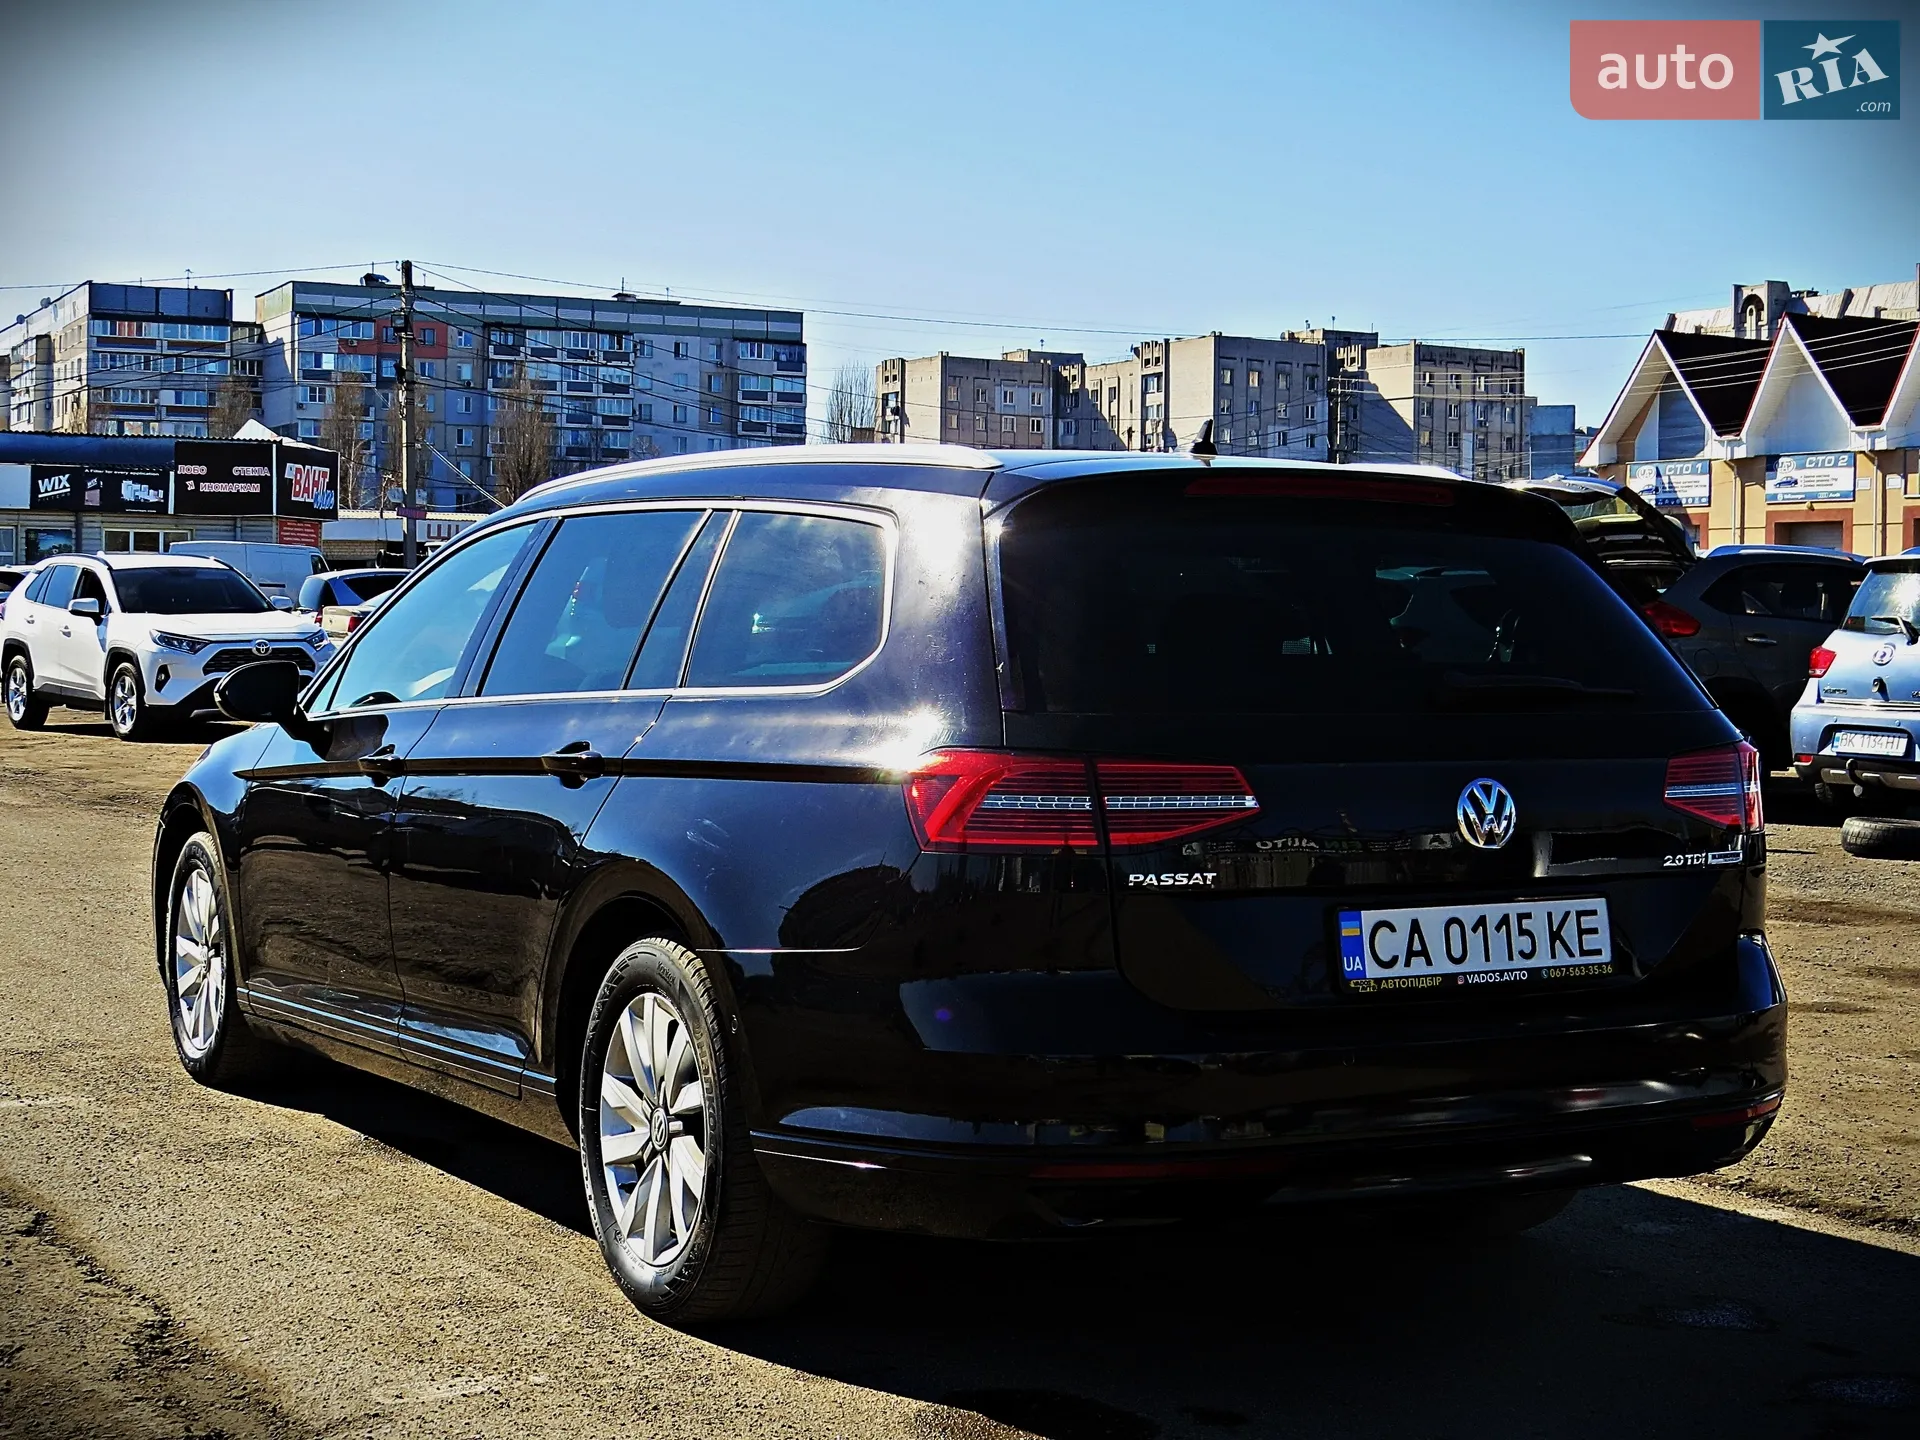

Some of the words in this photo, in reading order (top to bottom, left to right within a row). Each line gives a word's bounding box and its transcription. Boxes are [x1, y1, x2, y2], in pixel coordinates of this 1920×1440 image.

[1805, 456, 1835, 468] СТО
[1838, 455, 1849, 466] 2
[1665, 463, 1692, 475] СТО
[1695, 463, 1702, 474] 1
[38, 473, 71, 493] WIX
[199, 482, 260, 493] ИНОМАРКАМ
[1128, 872, 1217, 887] PASSAT
[1368, 917, 1434, 970] CA
[1443, 911, 1539, 966] 0115
[1546, 908, 1604, 960] KE
[1343, 956, 1364, 972] UA
[1549, 964, 1613, 978] 067-563-35-36
[1380, 976, 1442, 990] АВТОПІДБІР
[1466, 971, 1528, 984] VADOS.AVTO
